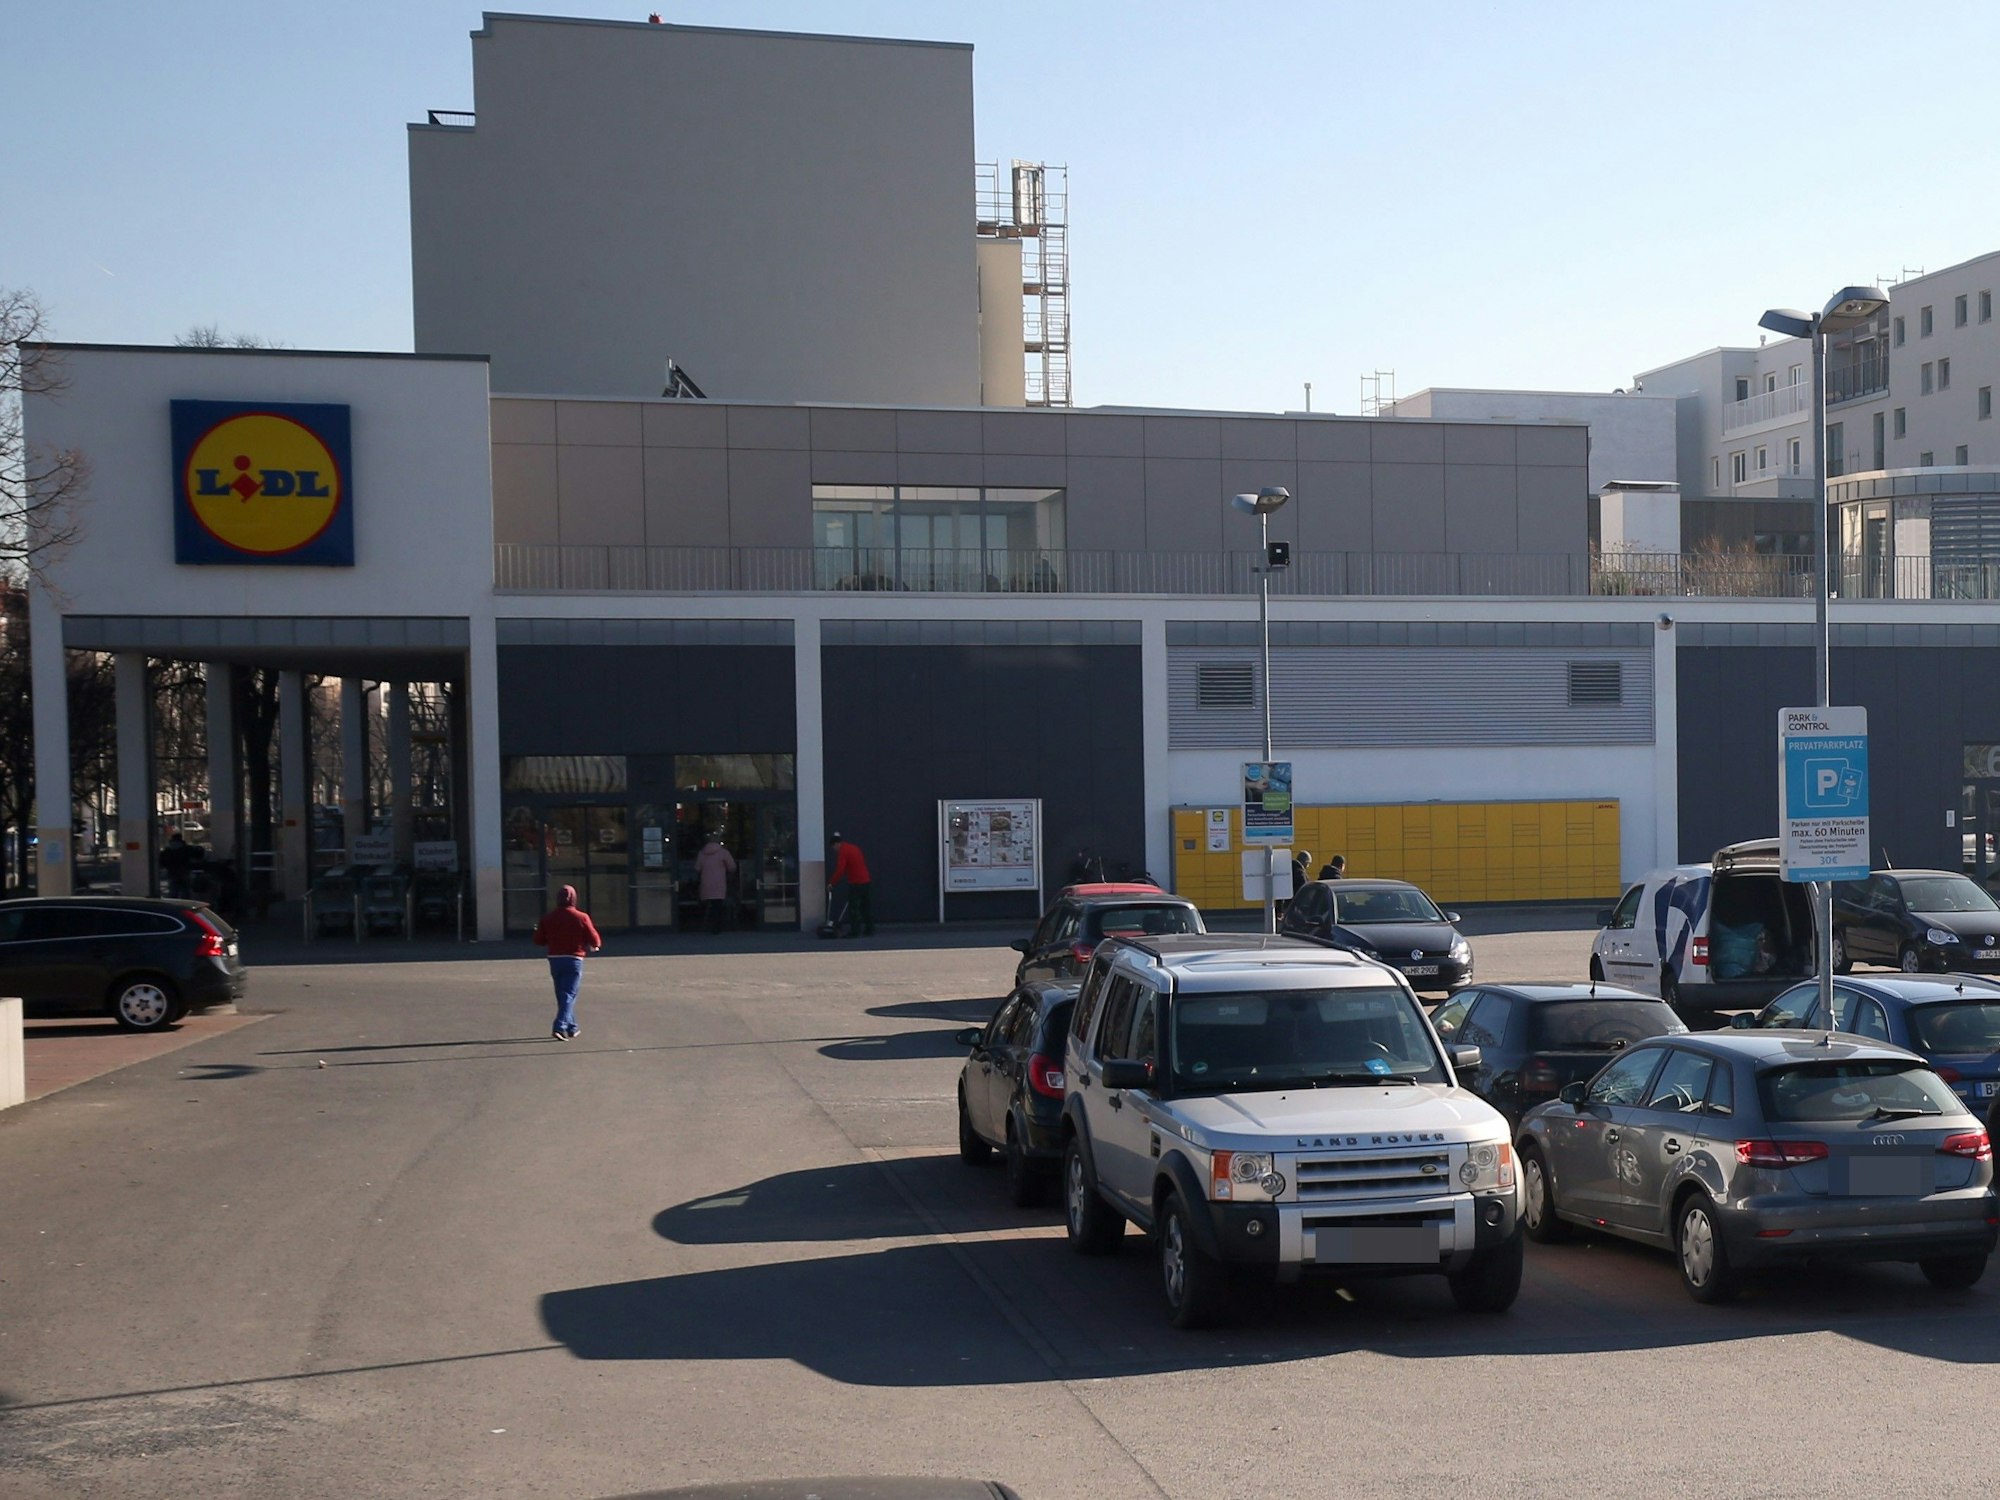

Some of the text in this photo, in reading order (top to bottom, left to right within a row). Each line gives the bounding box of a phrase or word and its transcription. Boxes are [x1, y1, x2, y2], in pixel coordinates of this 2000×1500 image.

[1788, 714, 1811, 722] PARK
[1788, 722, 1830, 731] CONTROL
[1788, 740, 1864, 751] PRIVATPARKPLATZ
[1817, 769, 1838, 797] P
[1791, 826, 1865, 838] max. 60 Minuten
[1985, 1083, 1993, 1095] B
[1297, 1133, 1445, 1147] LAND ROVER
